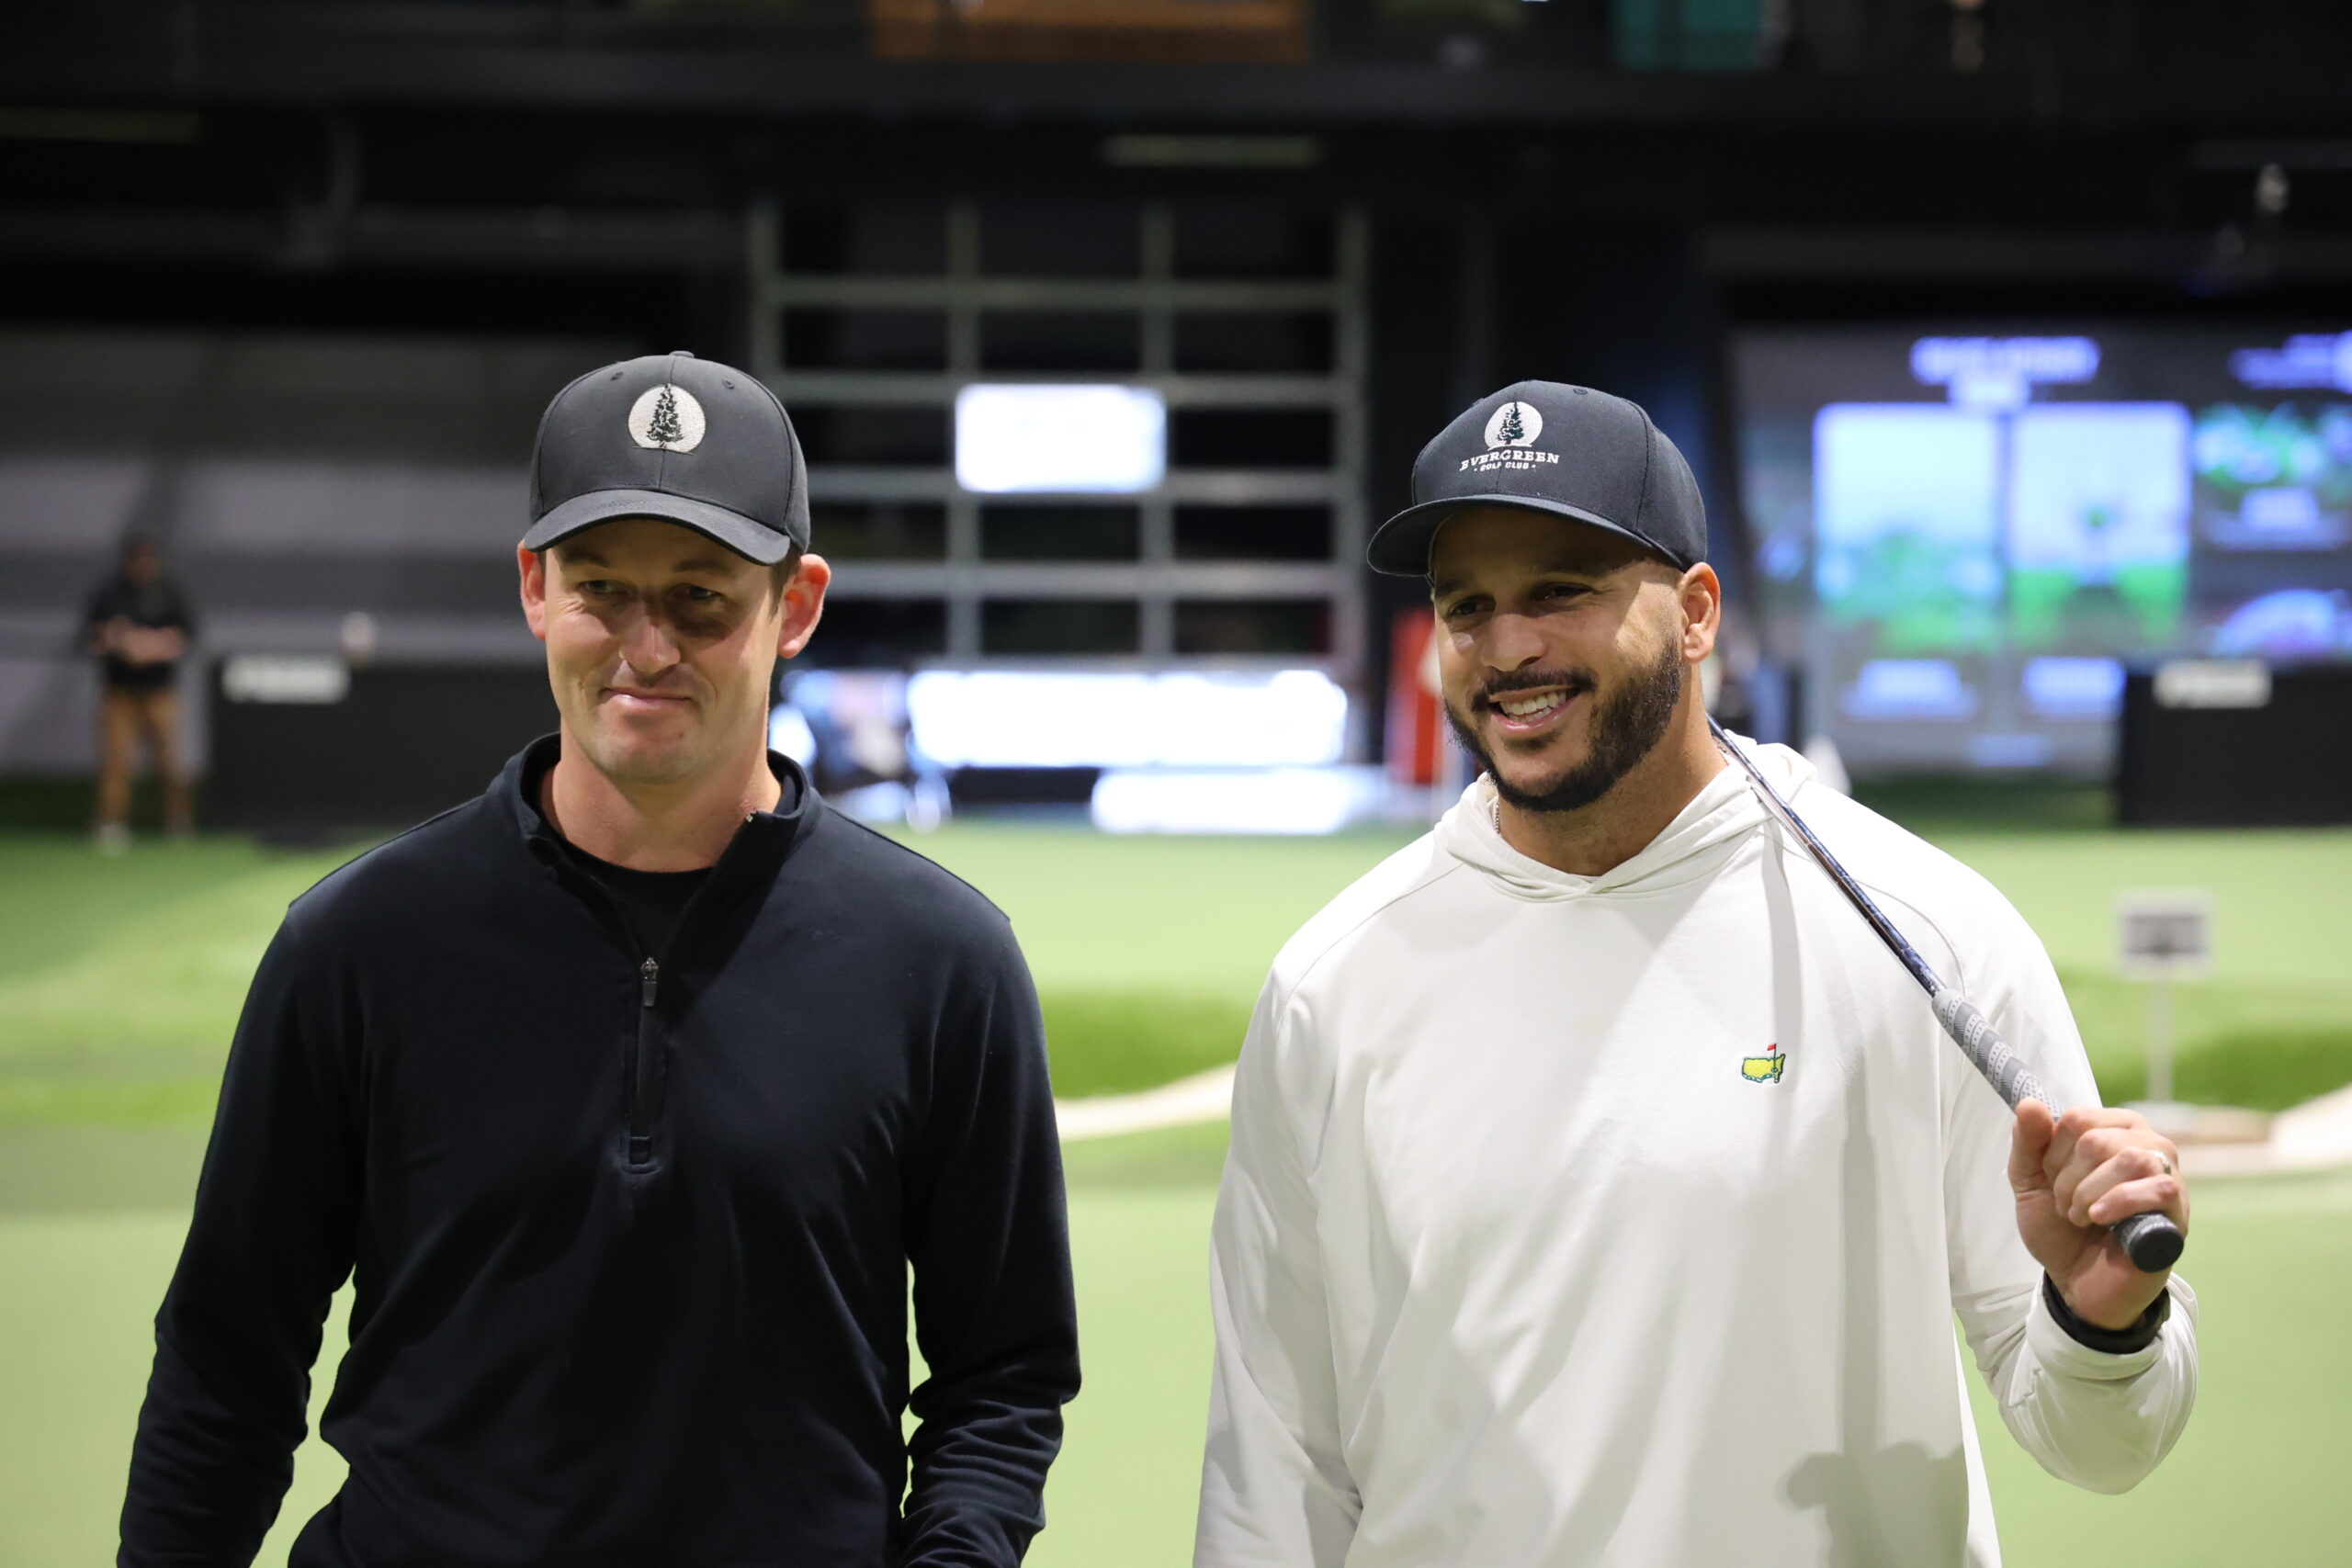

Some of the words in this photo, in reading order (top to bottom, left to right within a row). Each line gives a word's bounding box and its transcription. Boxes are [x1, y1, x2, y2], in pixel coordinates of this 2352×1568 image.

[1459, 449, 1560, 472] EVERGREEN
[1479, 462, 1502, 472] GOLF
[1505, 461, 1530, 469] CLUB
